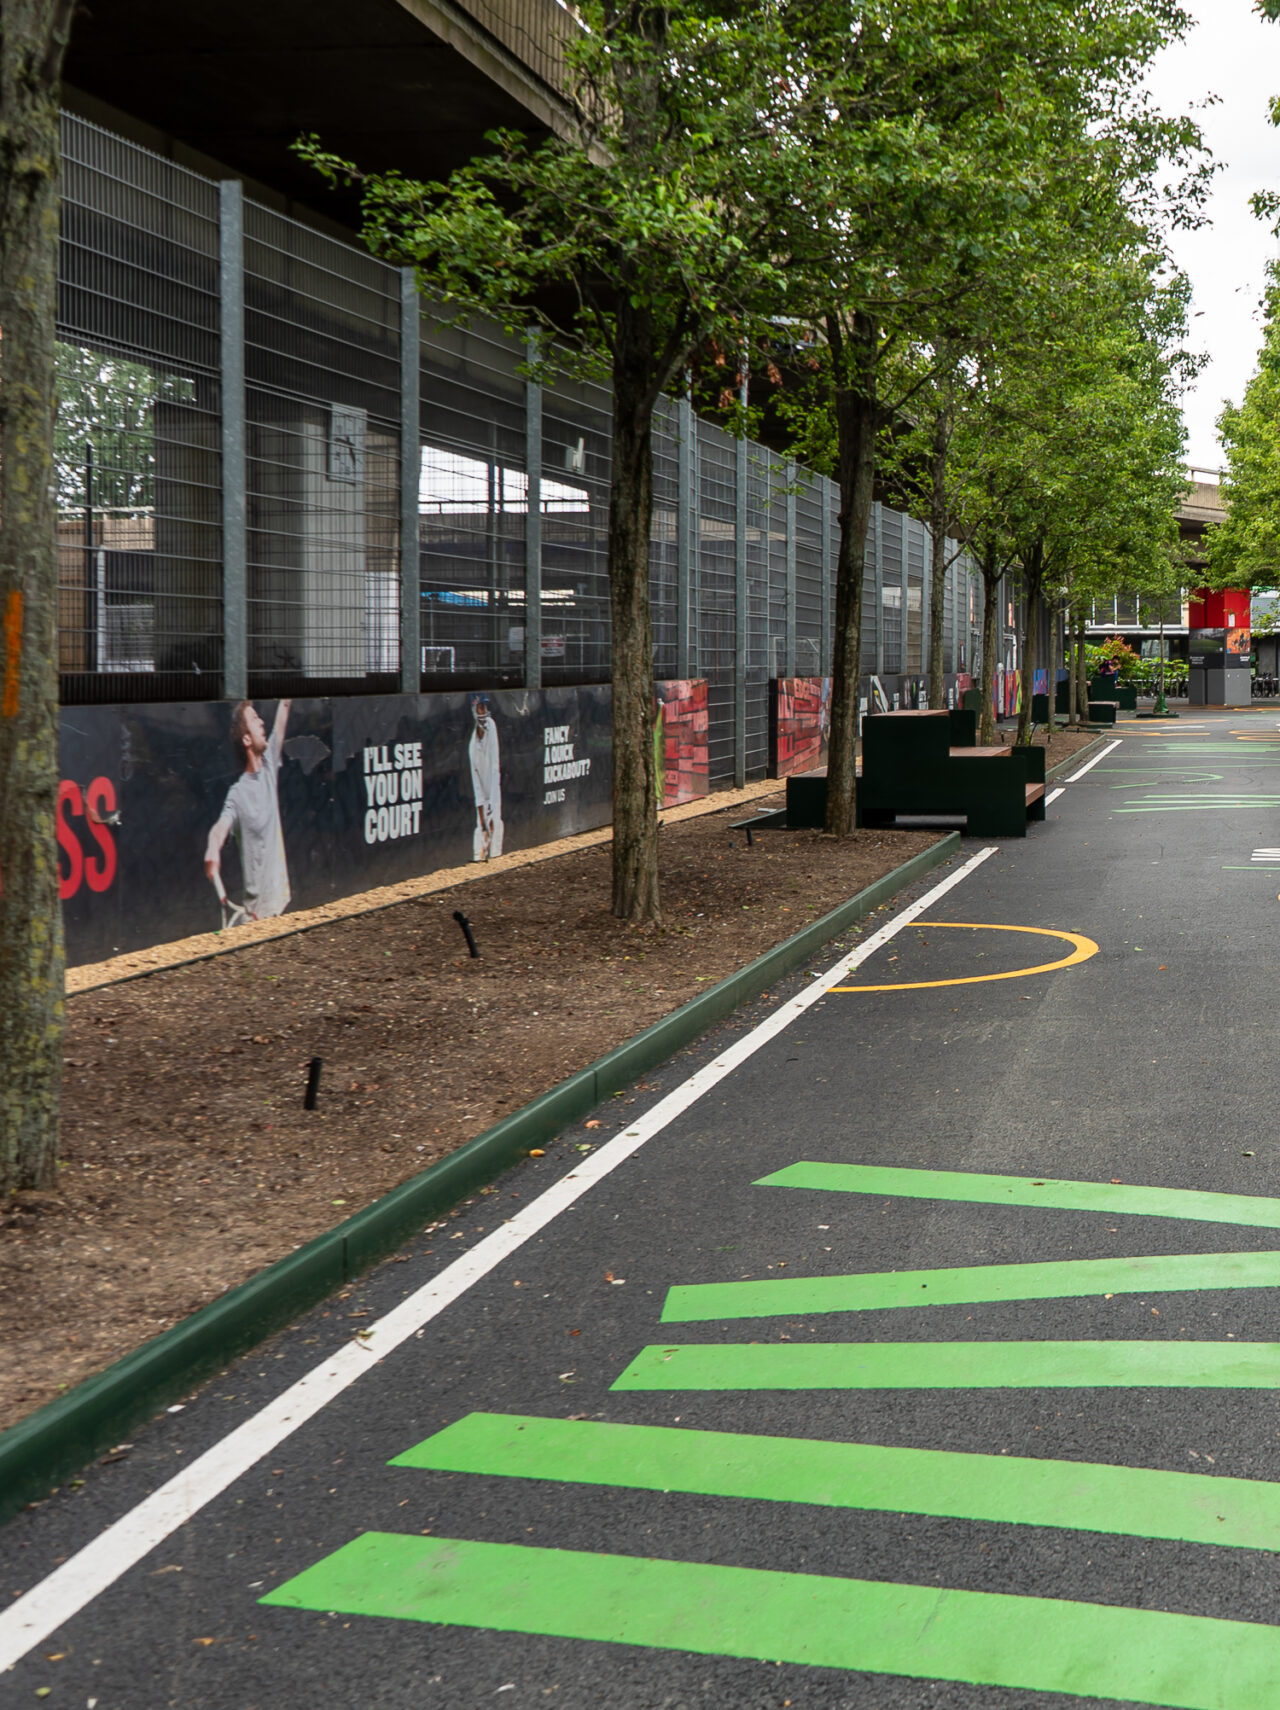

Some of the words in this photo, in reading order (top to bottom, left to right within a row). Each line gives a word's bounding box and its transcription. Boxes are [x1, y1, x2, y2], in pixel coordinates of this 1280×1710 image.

[544, 726, 569, 745] FANCY
[363, 746, 393, 774] I'LL
[394, 742, 423, 770] SEE
[544, 747, 551, 765] A
[551, 744, 574, 764] QUICK
[544, 759, 591, 784] KICKABOUT?
[364, 772, 399, 807] YOU
[401, 769, 423, 802] ON
[364, 801, 423, 844] COURT
